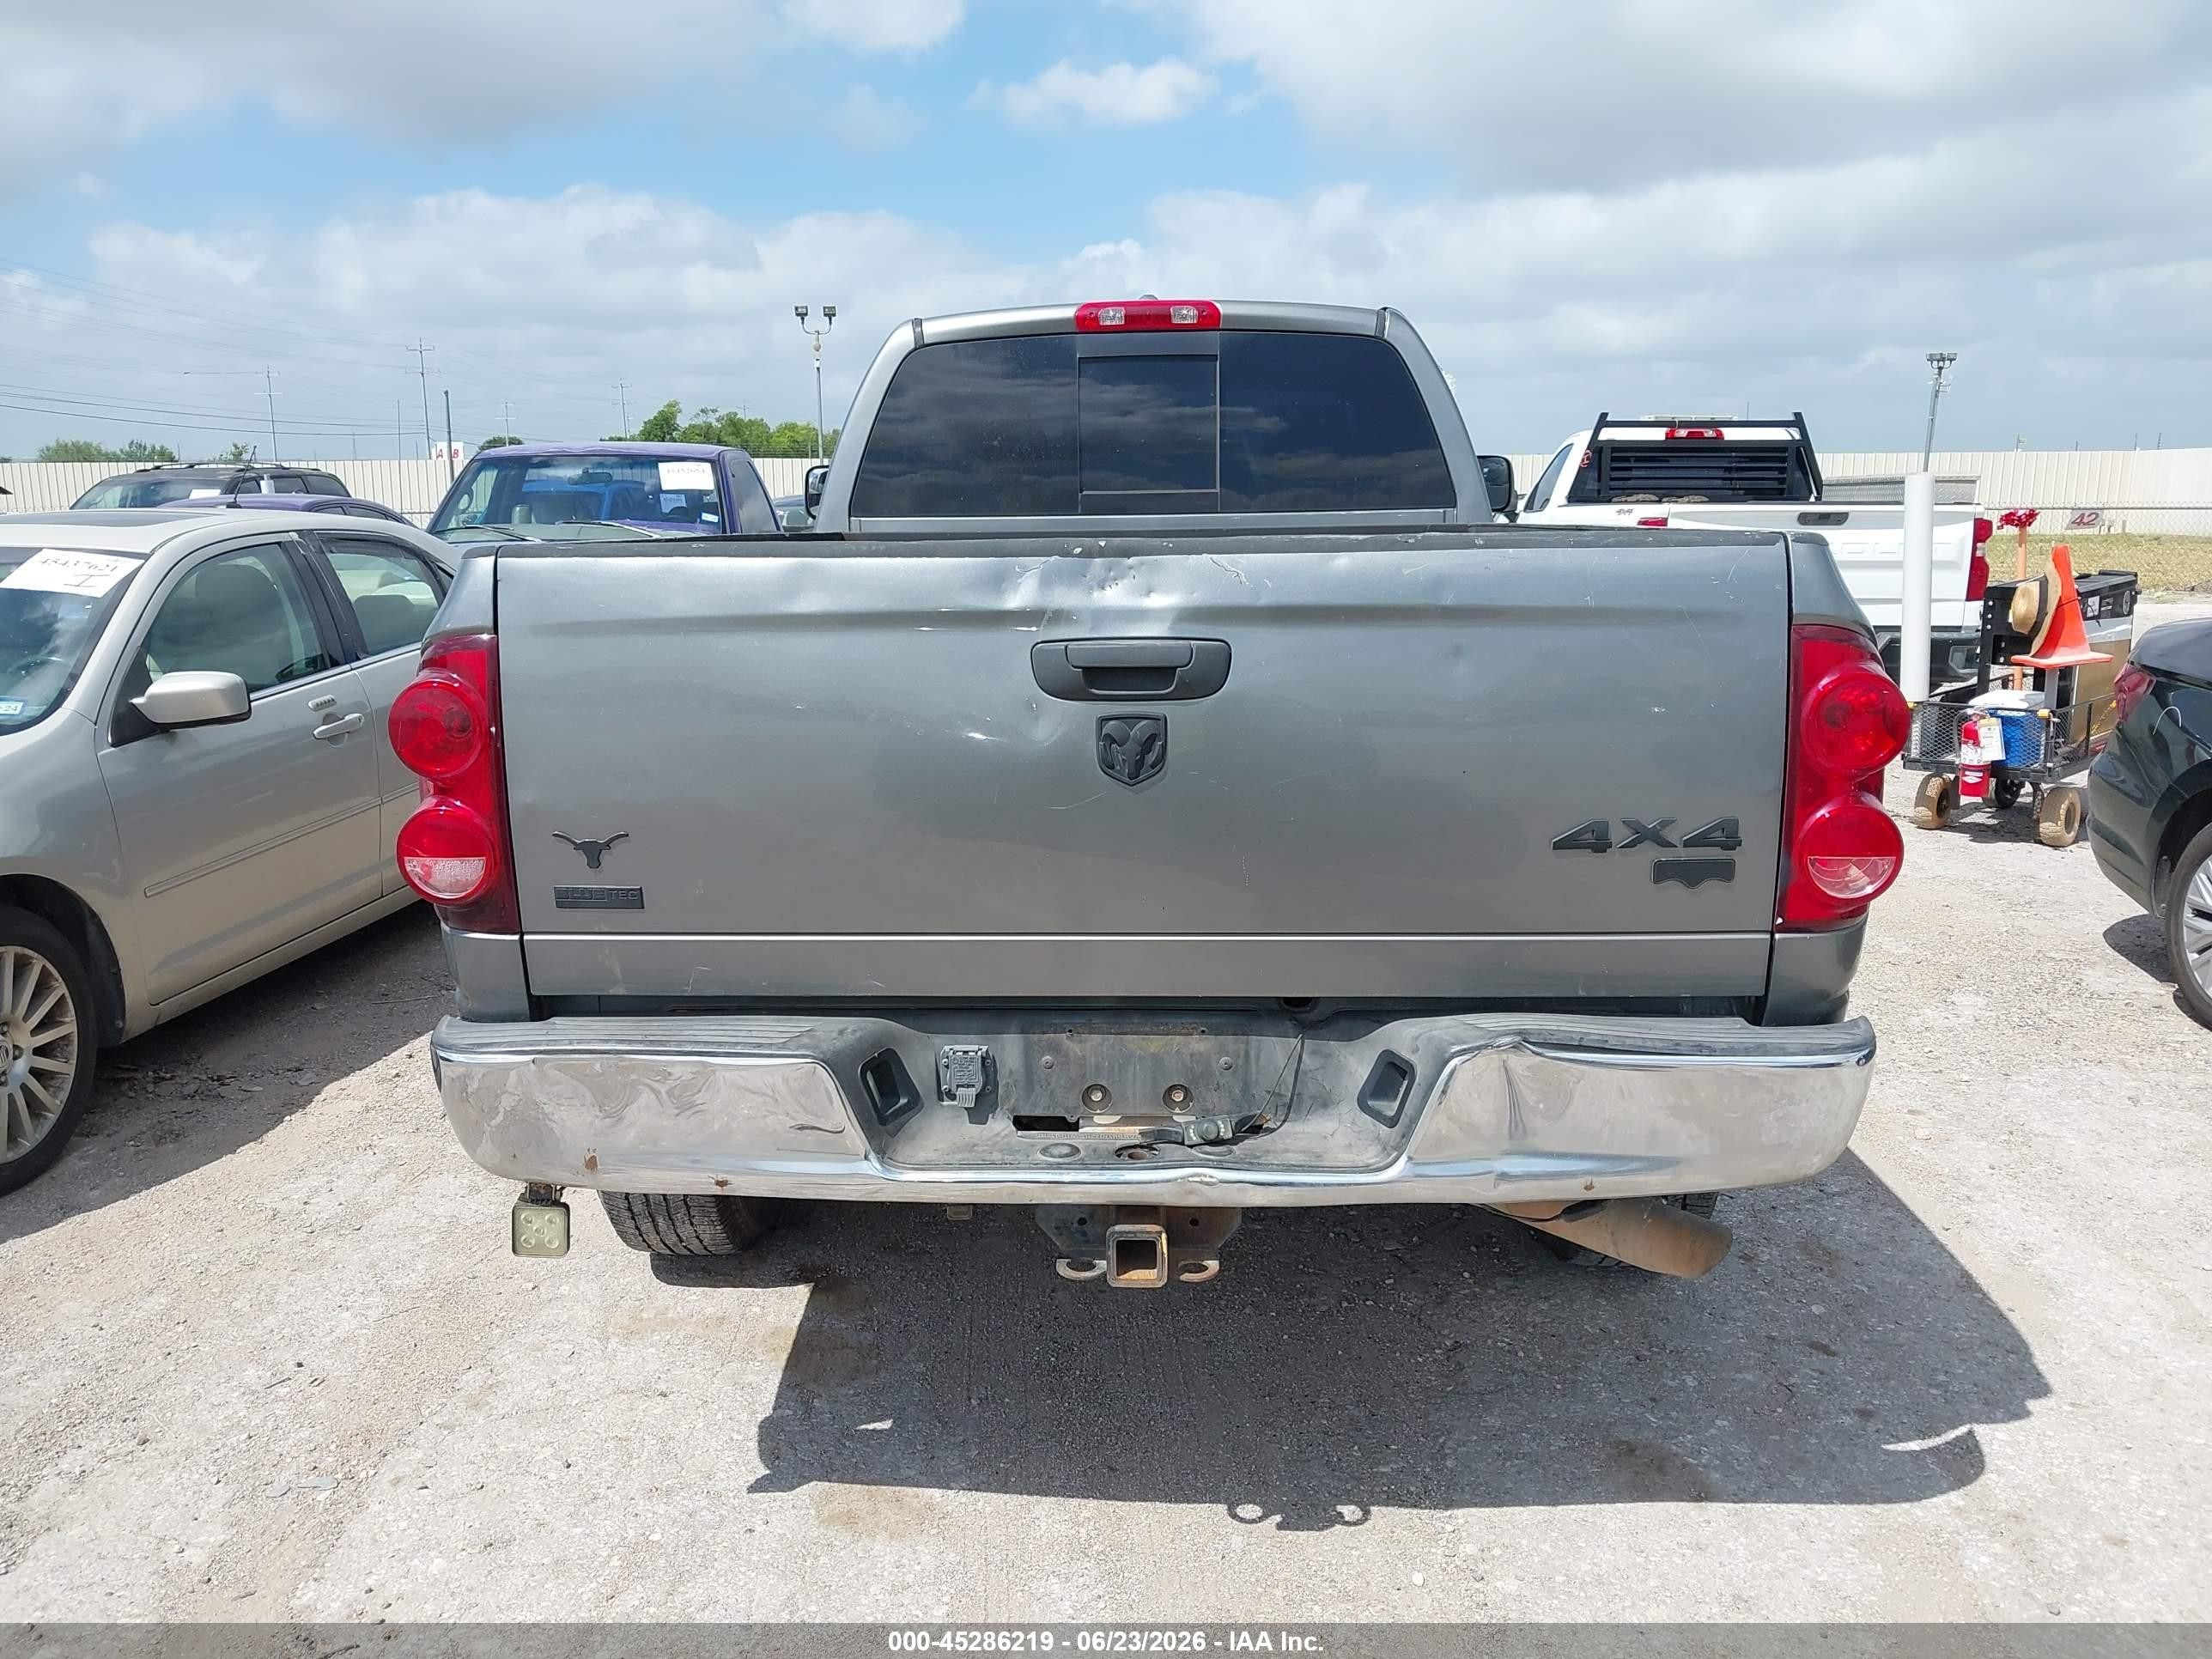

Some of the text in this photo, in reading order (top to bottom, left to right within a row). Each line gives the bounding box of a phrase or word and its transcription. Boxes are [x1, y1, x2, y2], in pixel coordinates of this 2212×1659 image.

[453, 448, 459, 459] B
[2071, 512, 2100, 526] 42
[1552, 817, 1743, 854] 4X4
